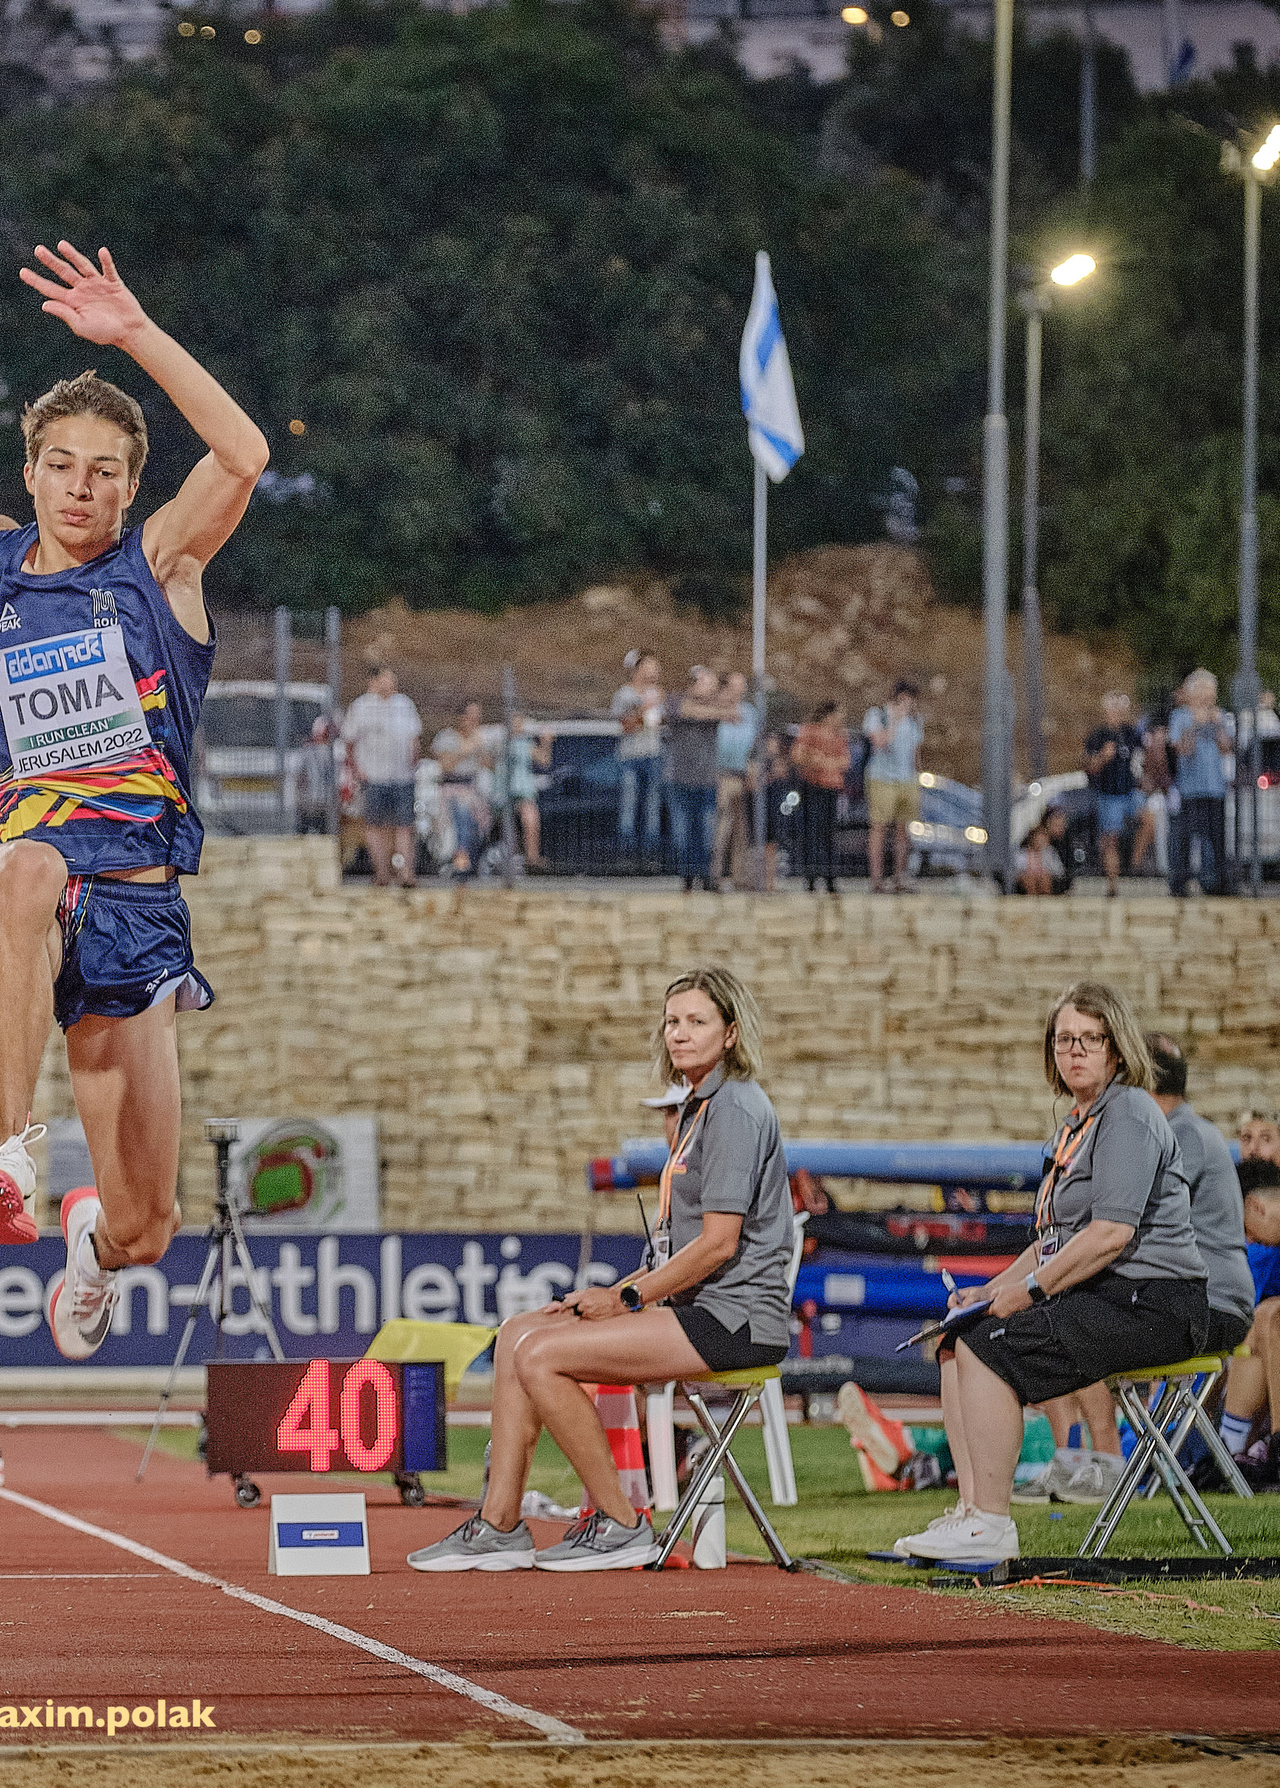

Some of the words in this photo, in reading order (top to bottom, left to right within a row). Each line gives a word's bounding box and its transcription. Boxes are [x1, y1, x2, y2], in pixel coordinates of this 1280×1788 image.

[93, 617, 118, 628] ROU
[9, 673, 124, 726] TOMA
[18, 741, 102, 773] JERUSALEM
[103, 727, 144, 752] 2022
[35, 731, 65, 748] RUN
[277, 1359, 397, 1472] 40
